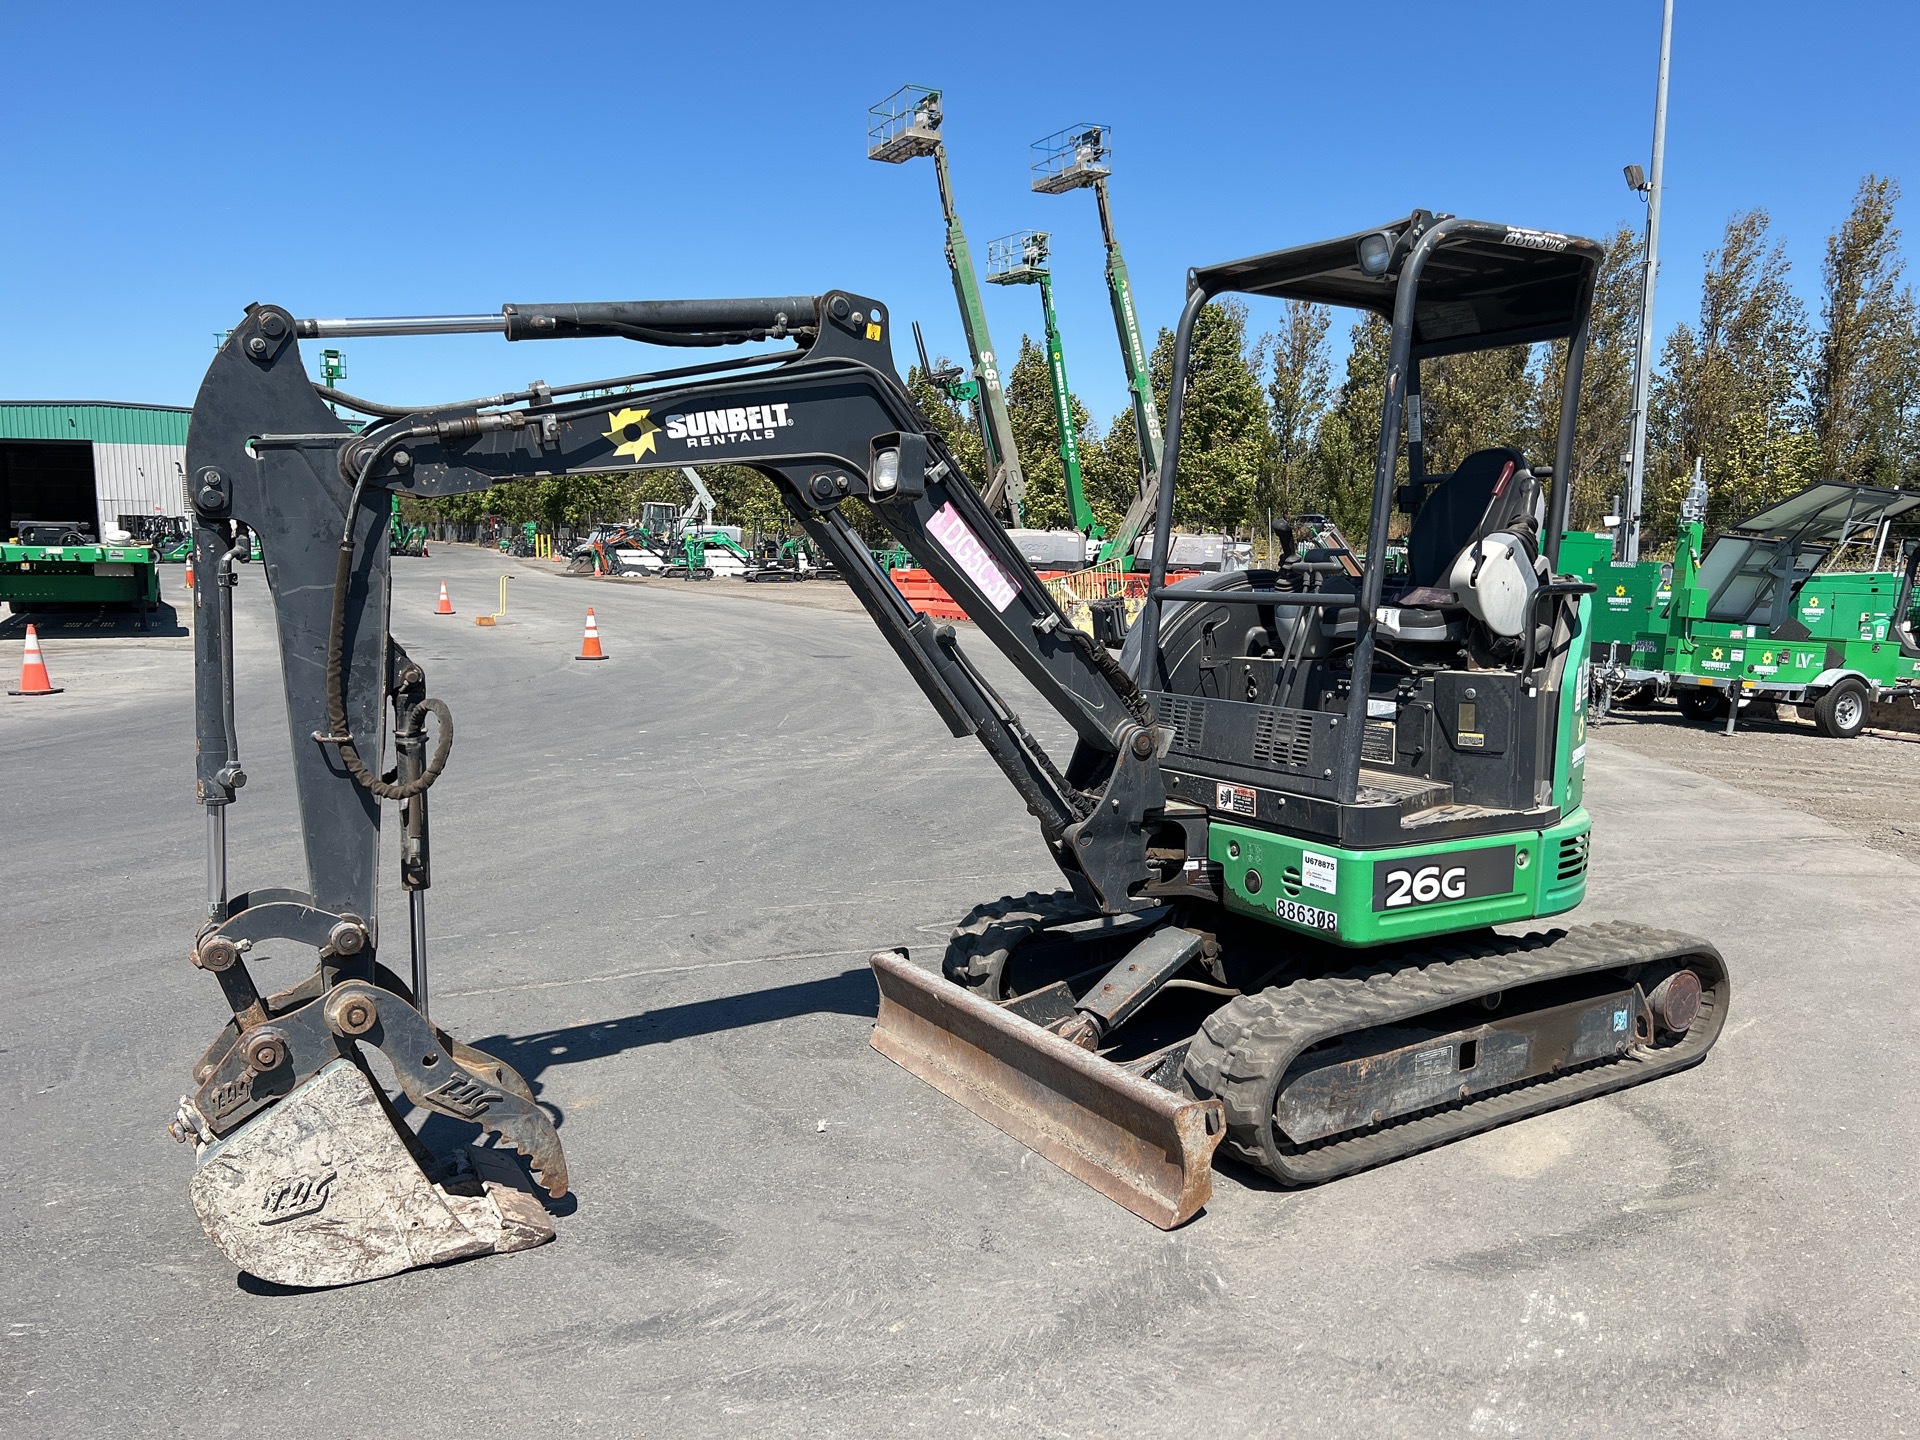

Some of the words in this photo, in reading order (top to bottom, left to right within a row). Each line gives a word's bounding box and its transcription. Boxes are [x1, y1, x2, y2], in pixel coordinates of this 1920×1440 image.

[980, 350, 1000, 392] S-65
[1055, 361, 1065, 393] SUNBELT
[1068, 450, 1077, 463] XC
[1143, 401, 1161, 439] S-65
[686, 428, 776, 448] RENTALS
[1304, 856, 1335, 871] U678875
[1385, 866, 1466, 907] 26G
[1277, 899, 1336, 931] 886308
